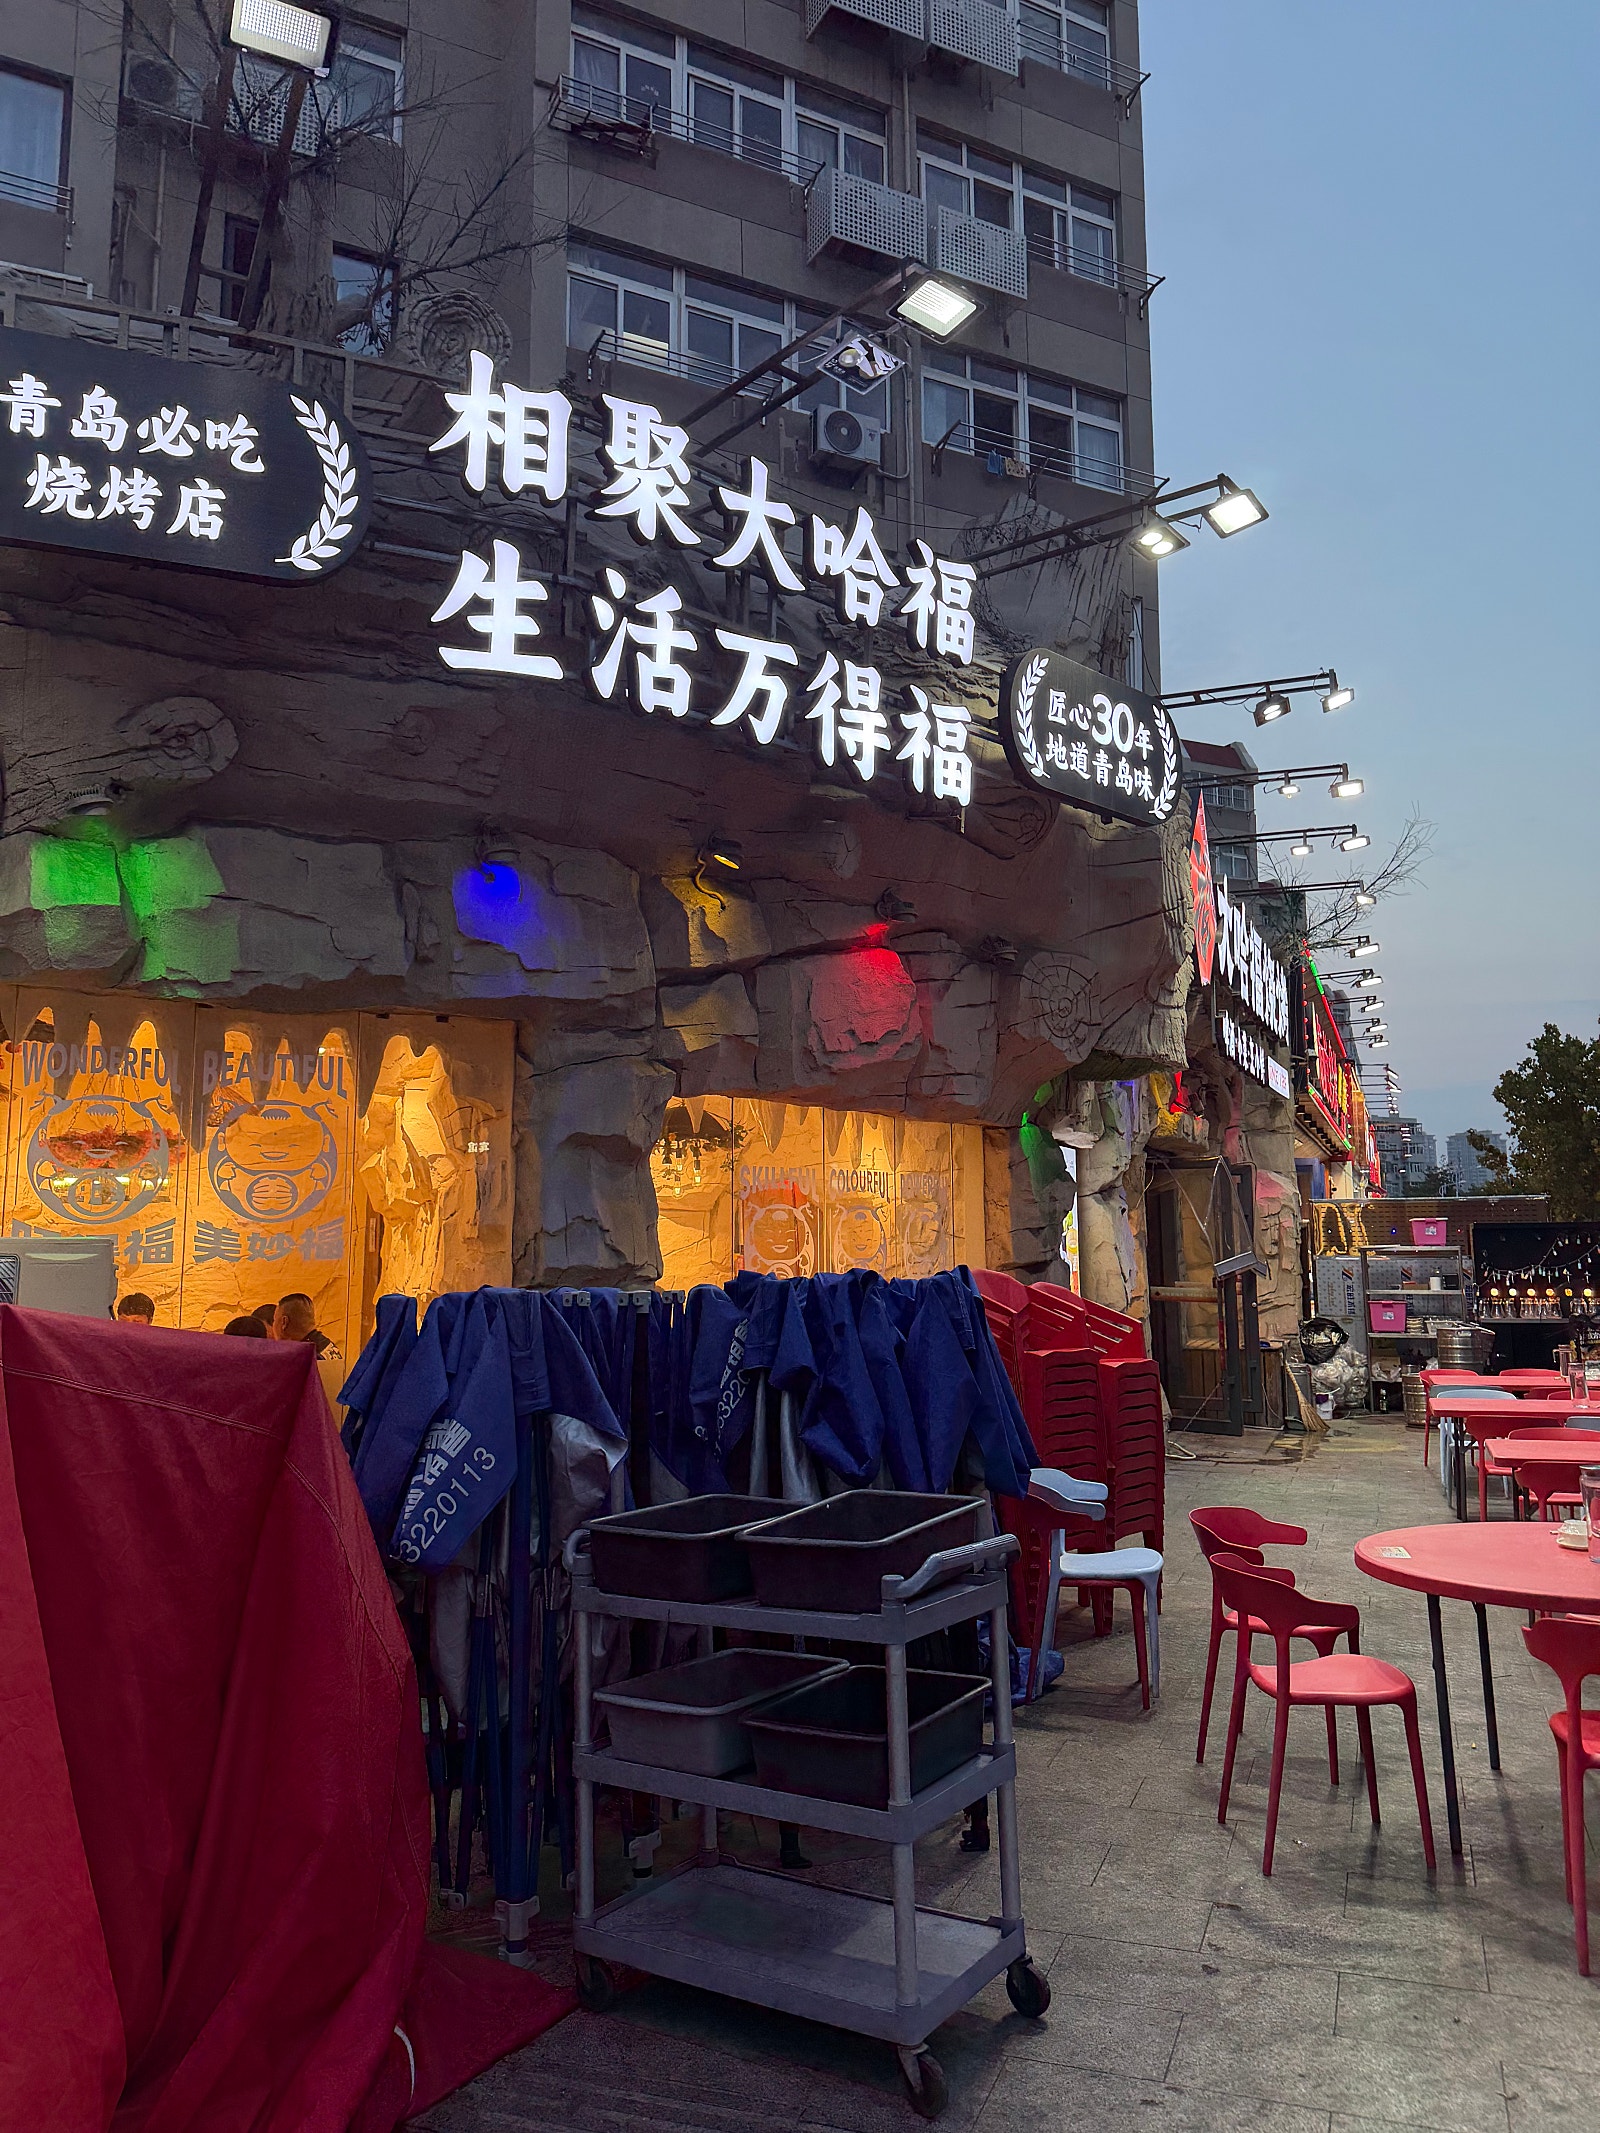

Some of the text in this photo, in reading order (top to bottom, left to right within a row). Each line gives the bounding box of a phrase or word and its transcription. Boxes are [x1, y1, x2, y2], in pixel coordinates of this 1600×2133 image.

[0, 372, 265, 473] 青岛必吃
[24, 453, 227, 541] 烧烤店
[428, 349, 977, 666] 相聚大哈福
[430, 538, 973, 807] 生活万得福
[1045, 732, 1156, 802] 地道青岛味
[22, 1042, 182, 1096] WONDERFUL
[202, 1050, 348, 1099] BEAUTIFUL
[739, 1165, 819, 1203] SKILLFUL
[830, 1168, 890, 1204] COLOURFUL
[193, 1215, 346, 1264] 美妙福
